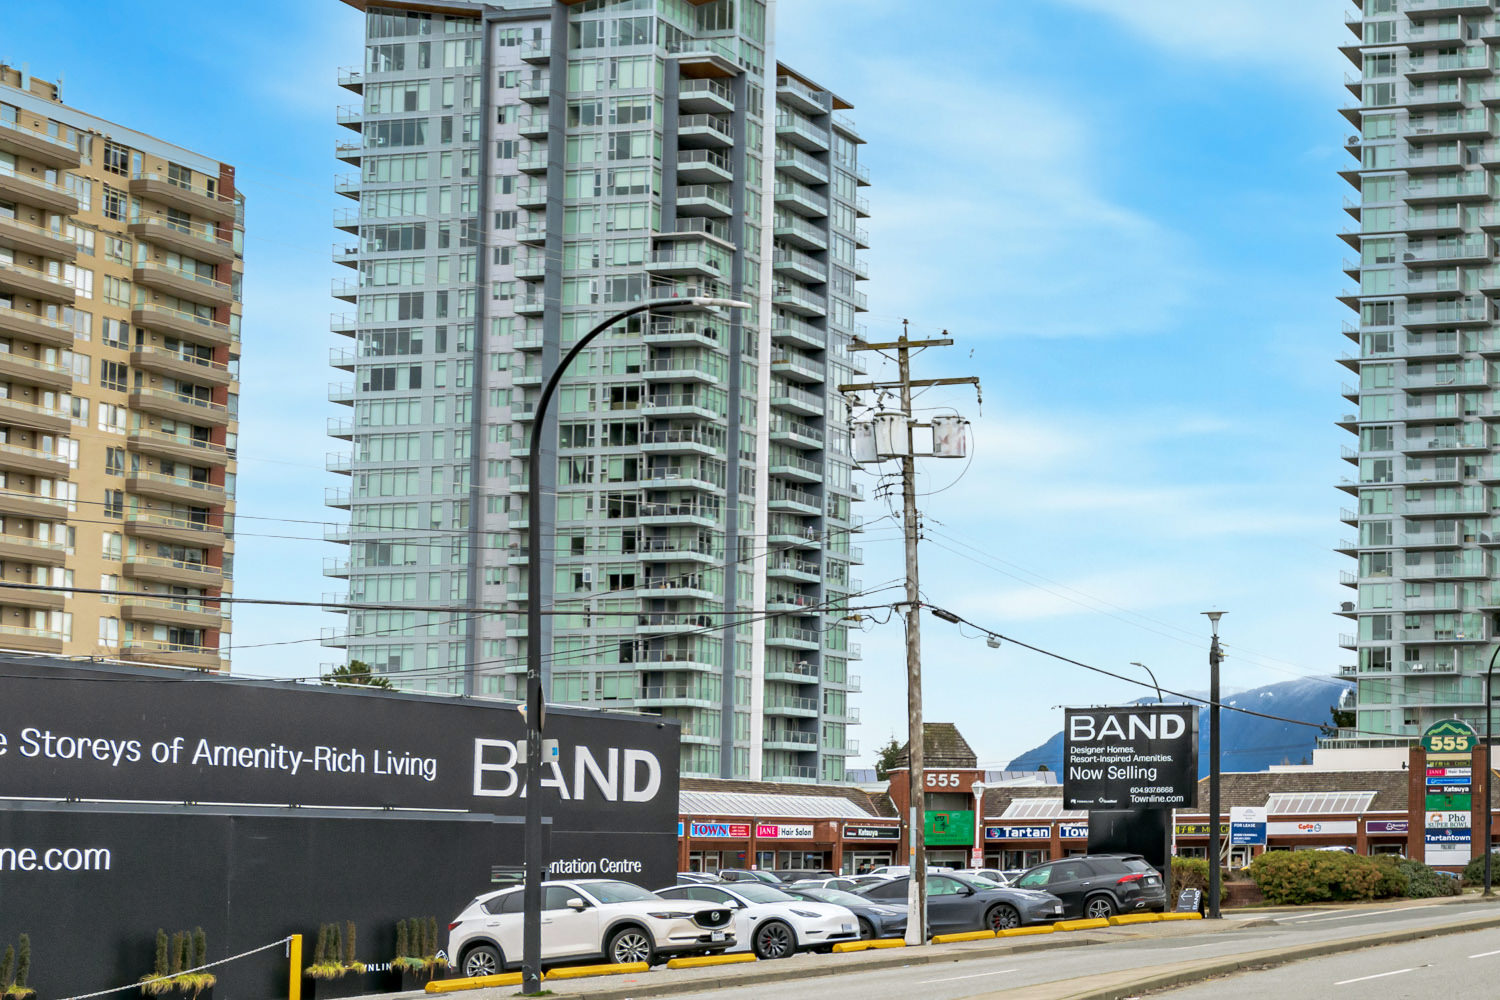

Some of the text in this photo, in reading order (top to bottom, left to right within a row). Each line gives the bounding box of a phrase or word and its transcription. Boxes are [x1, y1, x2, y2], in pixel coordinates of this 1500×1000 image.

[1070, 713, 1186, 741] BAND
[1430, 736, 1469, 751] 555
[19, 728, 142, 767] Storeys
[151, 737, 184, 764] of
[192, 738, 366, 776] Amenity-Rich
[373, 749, 437, 782] Living
[1070, 746, 1136, 755] Designer Homes.
[1070, 754, 1173, 763] Resort-Inspired Amenities.
[1070, 765, 1157, 782] Now Selling
[926, 773, 960, 787] 555
[1130, 794, 1184, 803] Townline.com
[693, 825, 727, 835] TOWN
[759, 828, 812, 837] JANE Hair Salon
[1003, 827, 1049, 838] Tartan
[1063, 827, 1089, 837] Tow
[1426, 834, 1471, 842] Tartantown
[600, 858, 642, 873] Centre
